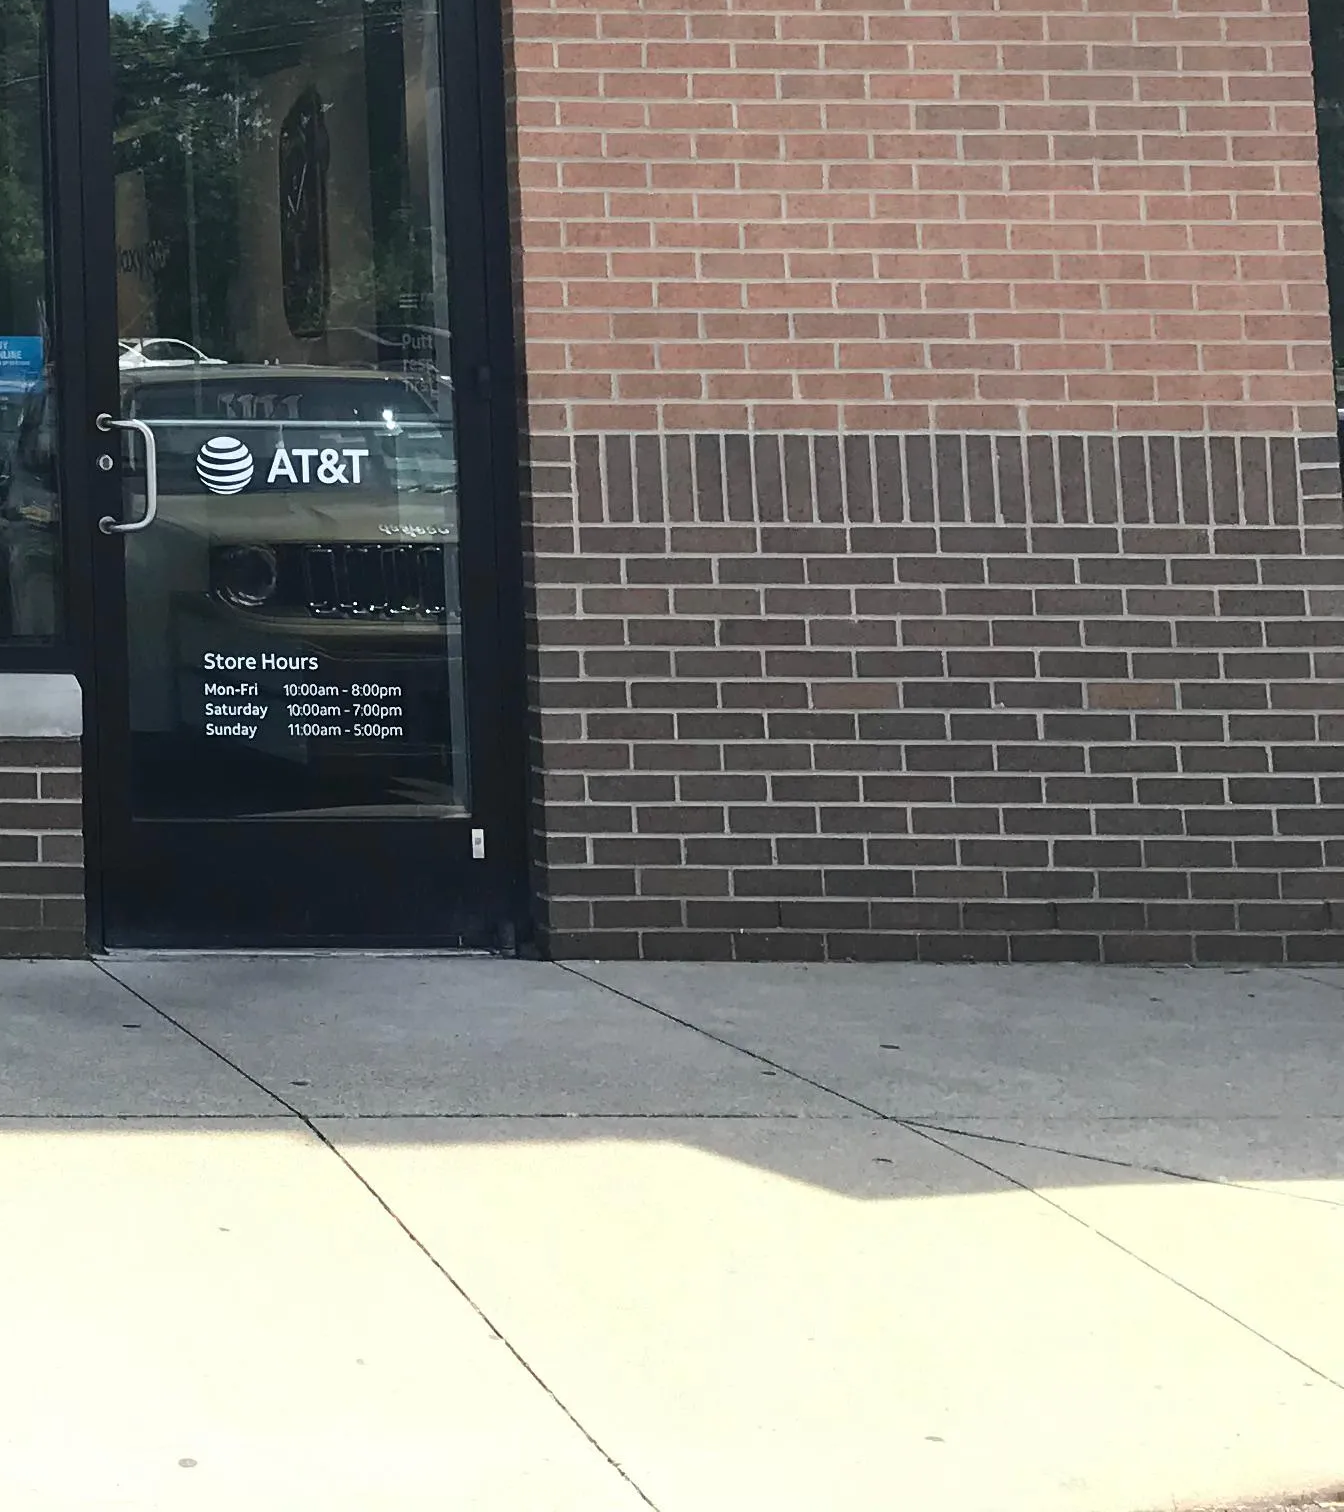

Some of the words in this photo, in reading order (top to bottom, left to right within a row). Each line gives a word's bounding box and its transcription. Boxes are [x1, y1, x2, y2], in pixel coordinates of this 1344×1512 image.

[266, 448, 370, 485] AT&T
[203, 652, 257, 671] Store
[261, 652, 319, 671] Hours
[204, 682, 259, 696] Mon-Fri
[283, 683, 339, 697] 10:00am
[351, 683, 403, 700] 8:00pm
[205, 702, 269, 720] Saturday
[286, 703, 342, 717] 10:00am
[352, 703, 403, 720] 7:00pm
[205, 722, 258, 739] Sunday
[287, 723, 342, 737] 11:00am
[353, 723, 404, 740] 5:00pm
